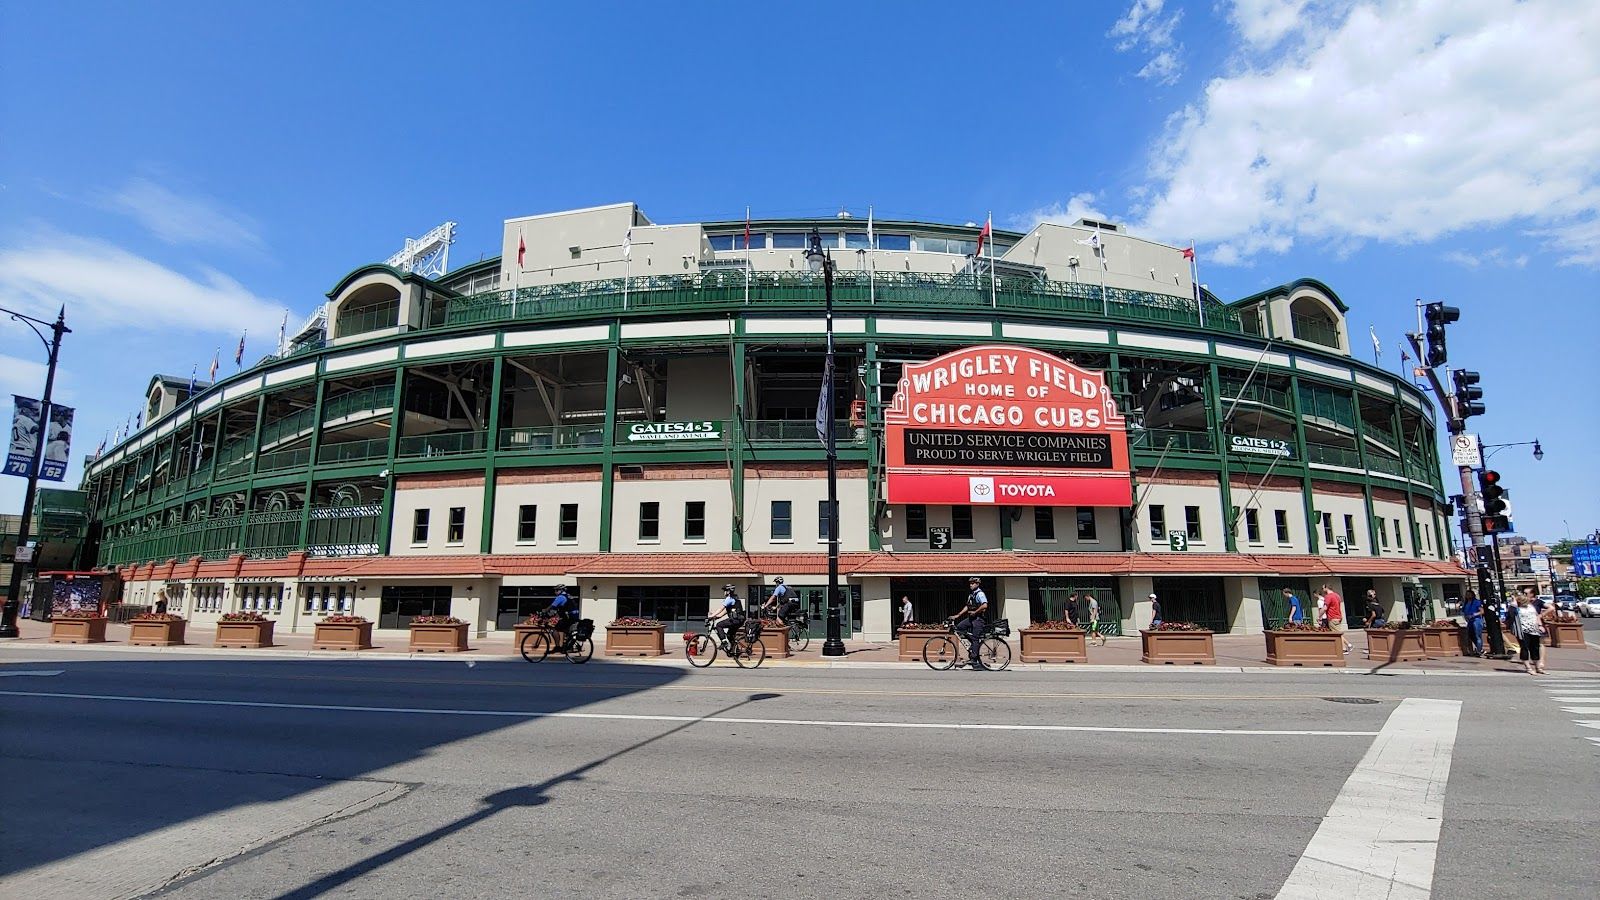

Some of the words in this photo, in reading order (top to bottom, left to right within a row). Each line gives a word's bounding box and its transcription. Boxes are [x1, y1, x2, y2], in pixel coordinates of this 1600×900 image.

[912, 354, 1018, 394] WRIGLEY
[1029, 358, 1097, 399] FIELD
[965, 383, 1015, 397] HOME
[1026, 385, 1049, 398] OF
[913, 403, 1023, 425] CHICAGO
[1034, 407, 1100, 428] CUBS
[631, 423, 685, 433] GATES
[909, 433, 963, 445] UNITED
[967, 434, 1025, 447] SERVICE
[1028, 436, 1106, 449] COMPANIES
[1232, 436, 1268, 447] GATES
[916, 448, 957, 459] PROUD
[959, 449, 975, 460] TO
[977, 450, 1014, 461] SERVE
[1016, 451, 1068, 462] WRIGLEY
[1070, 452, 1102, 463] FIELD
[999, 484, 1055, 496] TOYOTA
[933, 532, 947, 545] 3
[1173, 535, 1185, 547] 3
[1339, 539, 1347, 551] 3
